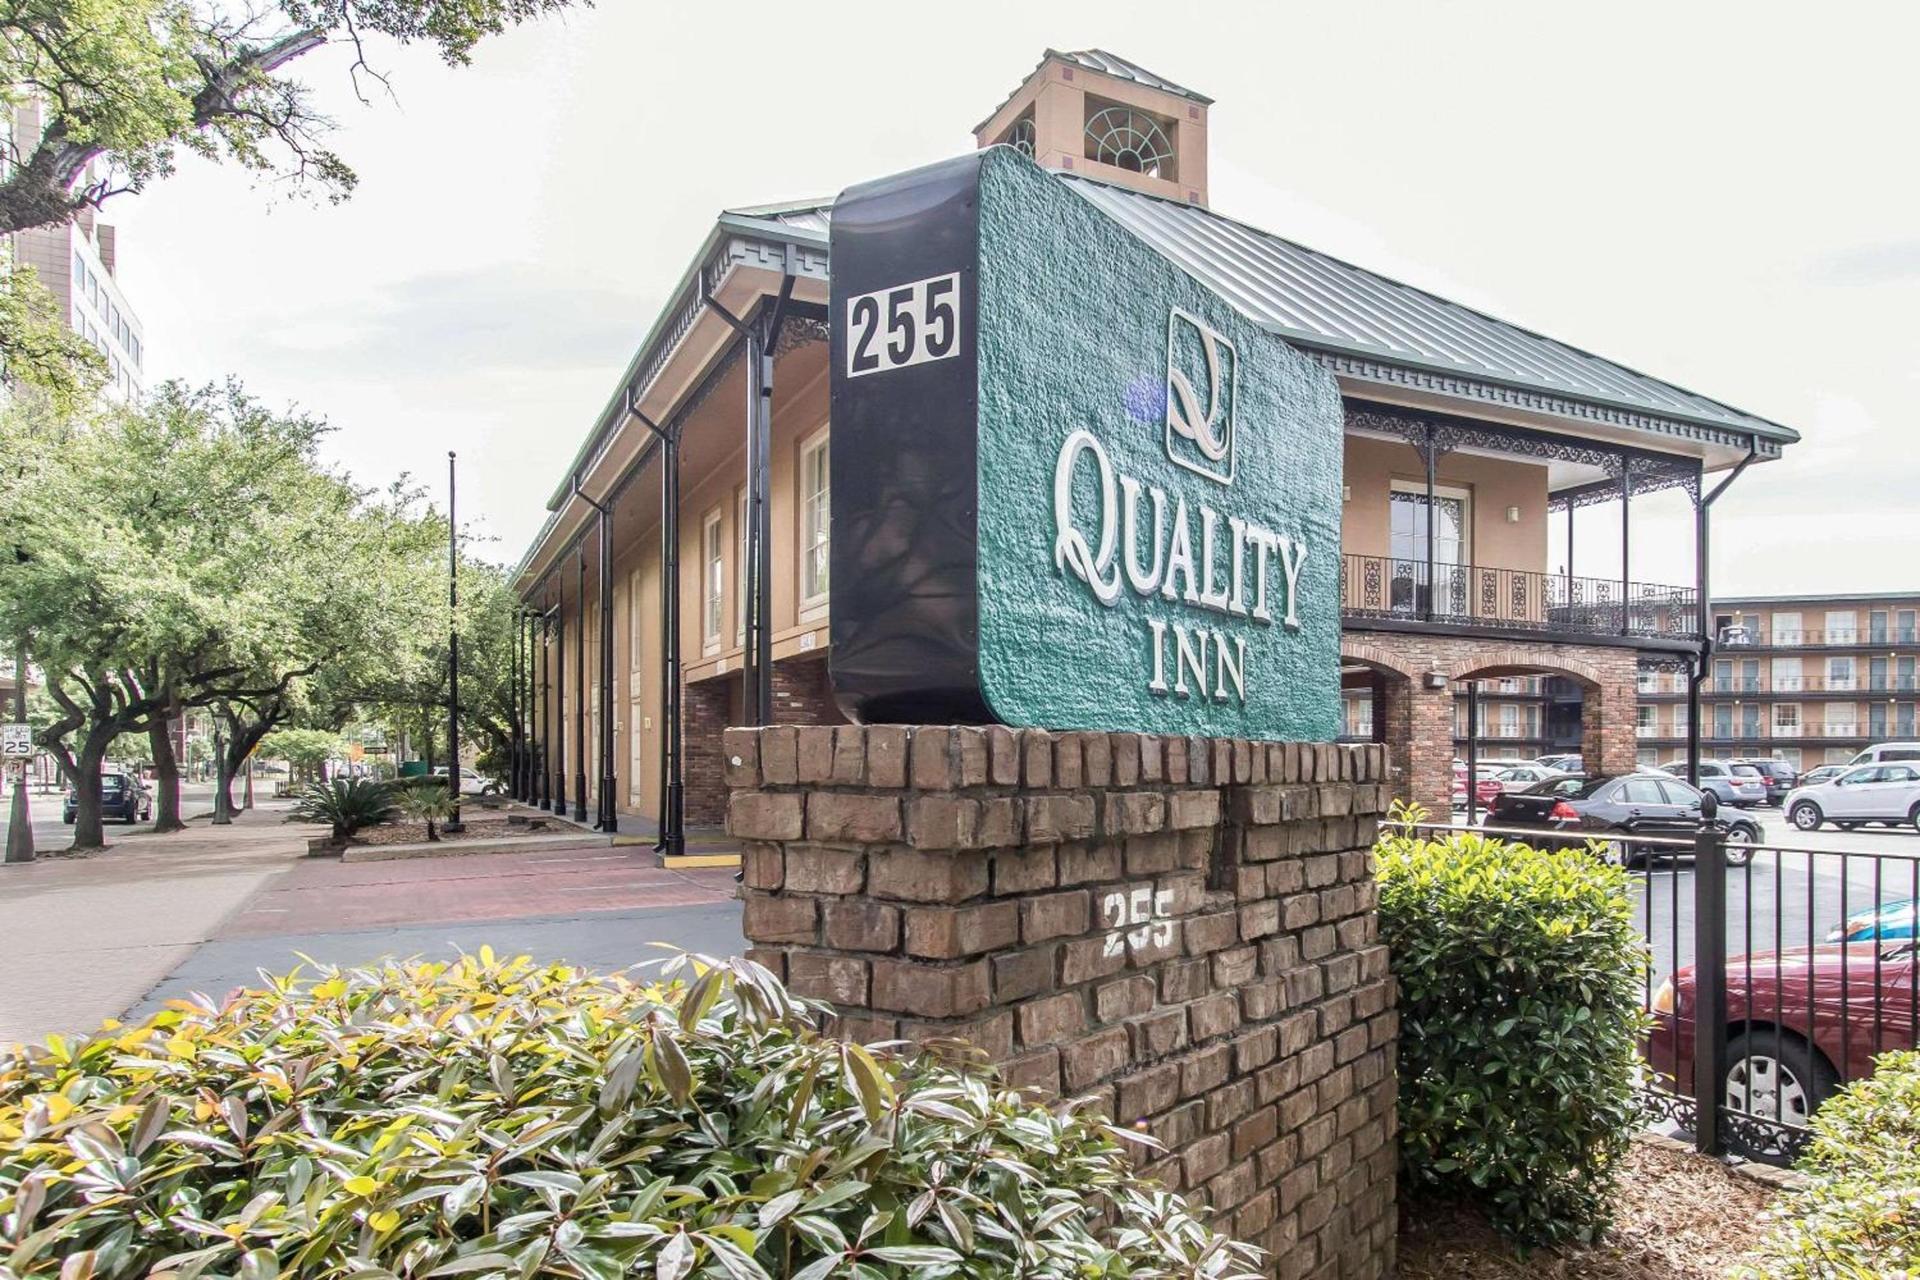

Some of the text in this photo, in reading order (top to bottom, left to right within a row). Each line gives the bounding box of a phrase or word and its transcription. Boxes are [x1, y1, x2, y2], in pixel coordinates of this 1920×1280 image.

[852, 277, 955, 373] 255
[1055, 429, 1308, 631] QUALITY
[1147, 619, 1247, 704] INN
[5, 742, 30, 753] 25
[1103, 888, 1173, 957] 255
